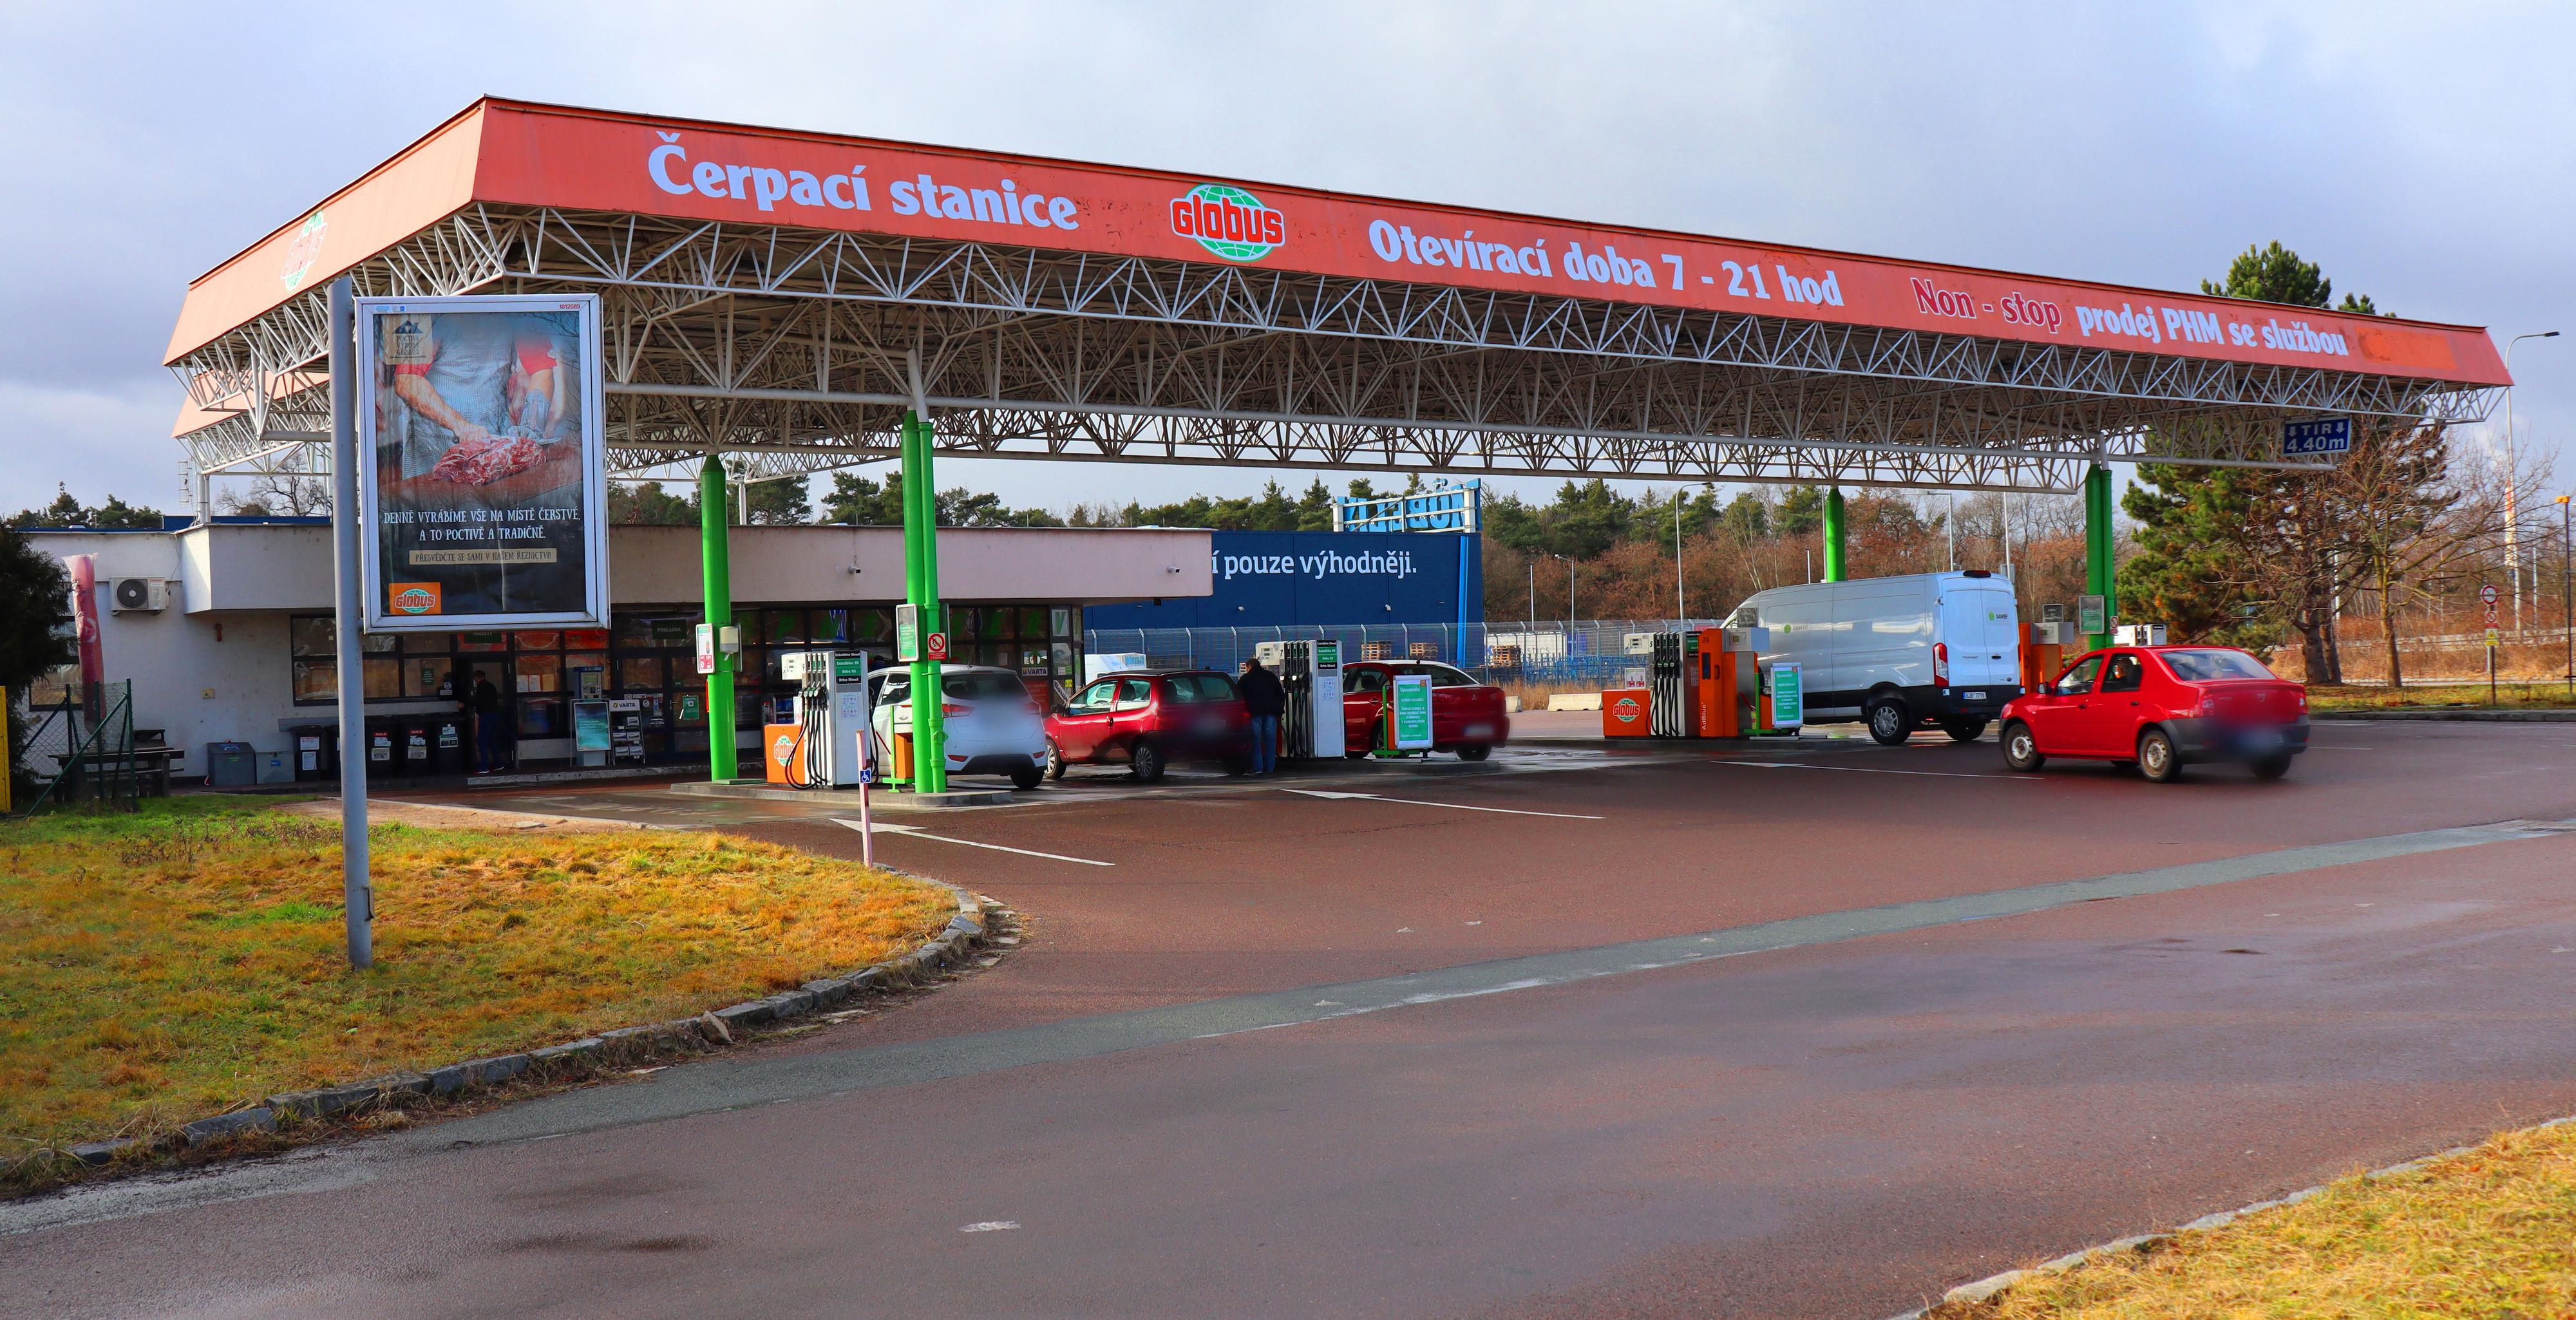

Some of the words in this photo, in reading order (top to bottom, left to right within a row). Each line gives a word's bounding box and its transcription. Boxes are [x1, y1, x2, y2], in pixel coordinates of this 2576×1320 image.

[648, 131, 872, 211] Čerpací
[891, 174, 1079, 230] stanice
[1172, 195, 1283, 244] Globus
[1368, 218, 1553, 278] Otevírací
[1564, 241, 1657, 288] doba
[1662, 254, 1684, 290] 7
[1721, 261, 1770, 299] 21
[1776, 265, 1844, 306] hod
[1910, 278, 1976, 319] Non
[2000, 292, 2061, 334] stop
[2076, 304, 2159, 344] prodej
[2161, 308, 2224, 344] PHM
[2228, 323, 2258, 348] se
[2262, 319, 2349, 356] službou
[2302, 423, 2331, 436] TIR
[384, 511, 414, 523] DENNĚ
[419, 509, 467, 523] VYRÁBÍME
[471, 509, 487, 522] VŠE
[490, 510, 504, 521] NA
[507, 507, 535, 521] MÍSTĚ
[538, 506, 581, 521] ČERSTVÉ,
[419, 531, 426, 541] A
[430, 529, 442, 541] TO
[446, 526, 484, 540] POCTIVĚ
[488, 529, 495, 540] A
[498, 526, 546, 540] TRADIČNĚ.
[457, 552, 465, 561] SE
[467, 552, 482, 561] SAMI
[486, 552, 490, 561] V
[492, 551, 514, 561] NAŠEM
[1224, 556, 1294, 580] pouze
[1300, 551, 1417, 580] výhodněji.
[395, 593, 435, 607] Globus
[1613, 702, 1640, 716] Globus
